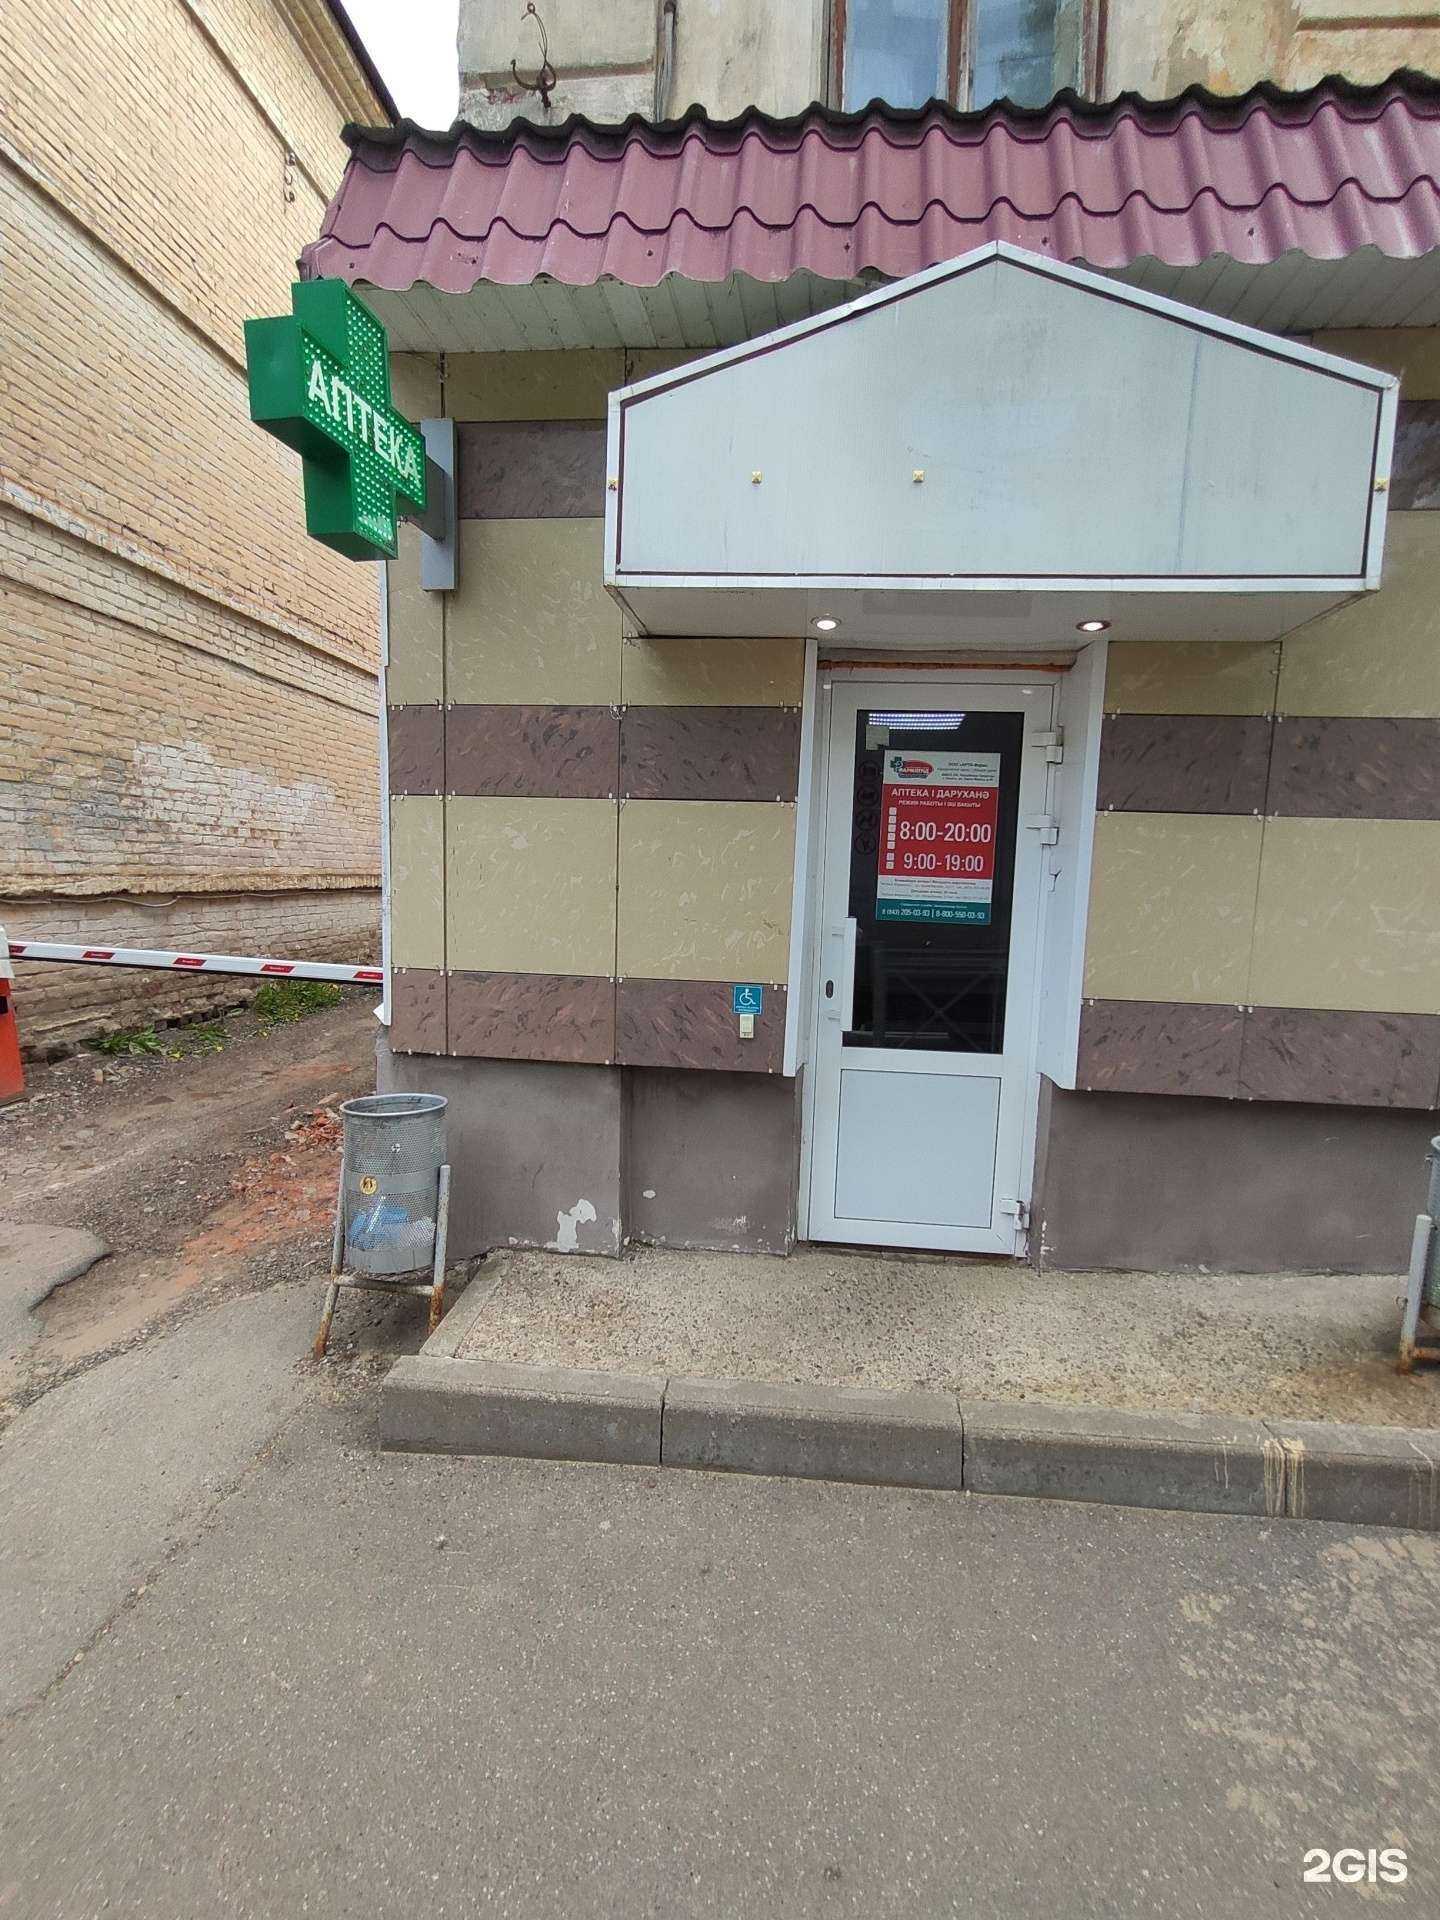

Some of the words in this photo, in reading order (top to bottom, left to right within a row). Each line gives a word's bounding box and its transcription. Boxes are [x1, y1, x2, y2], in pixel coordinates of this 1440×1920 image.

[307, 359, 422, 489] АПТЕКА
[891, 788, 929, 798] АПТЕКА
[936, 789, 990, 799] ДАРУХАНӘ
[900, 821, 991, 843] 8:00-20:00
[903, 853, 984, 872] 9:00-19:00
